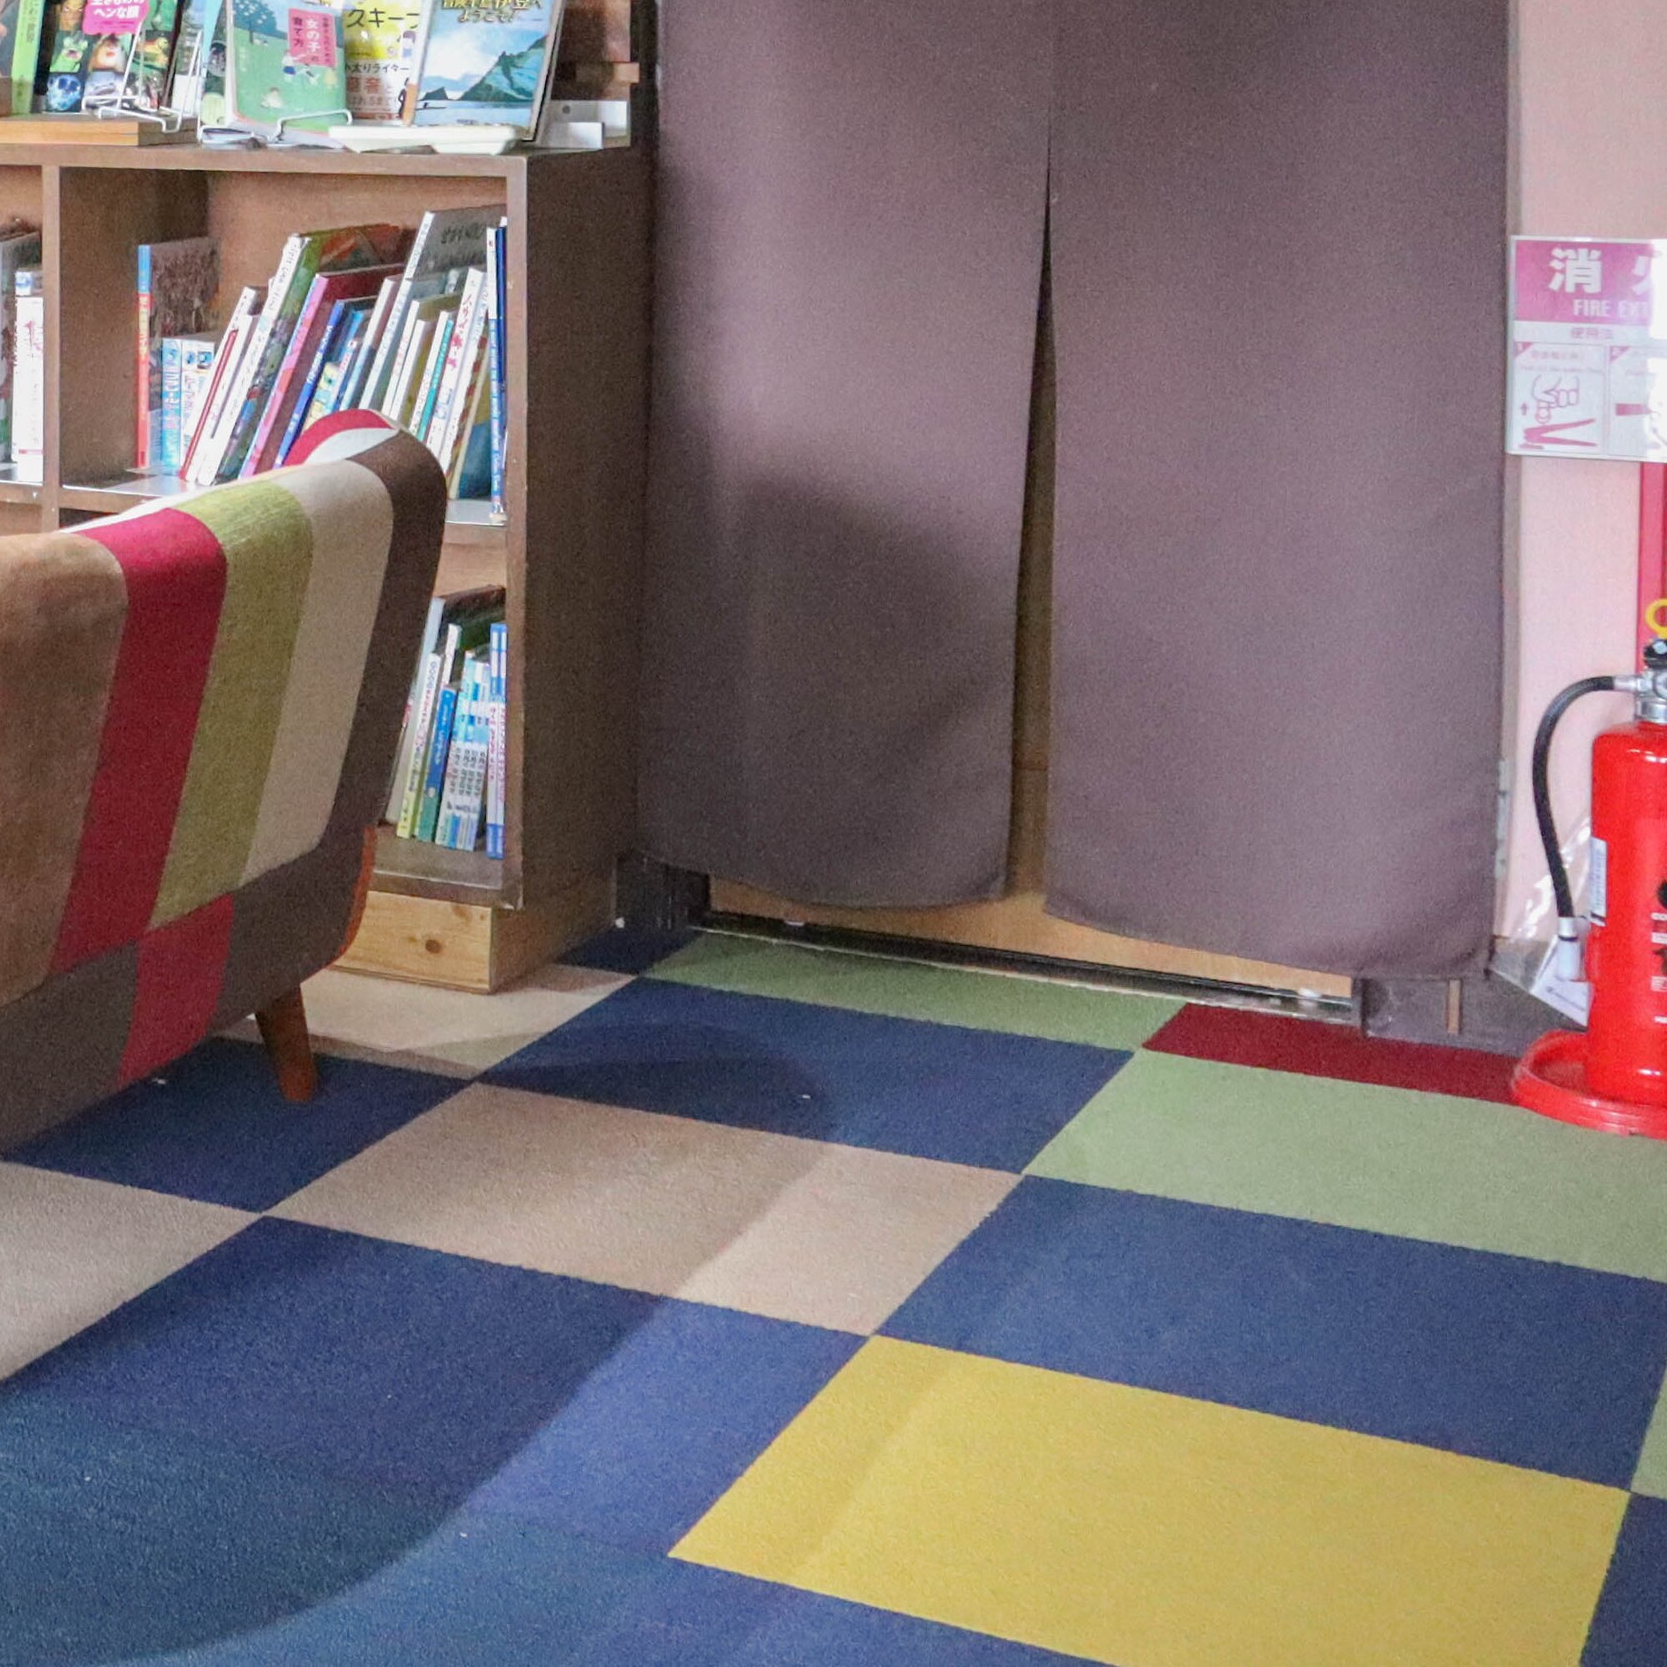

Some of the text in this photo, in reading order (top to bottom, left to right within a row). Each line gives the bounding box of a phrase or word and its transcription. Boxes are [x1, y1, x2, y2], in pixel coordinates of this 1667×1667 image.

[93, 4, 142, 20] ヘンな顔
[1573, 298, 1650, 320] FIRE EXT
